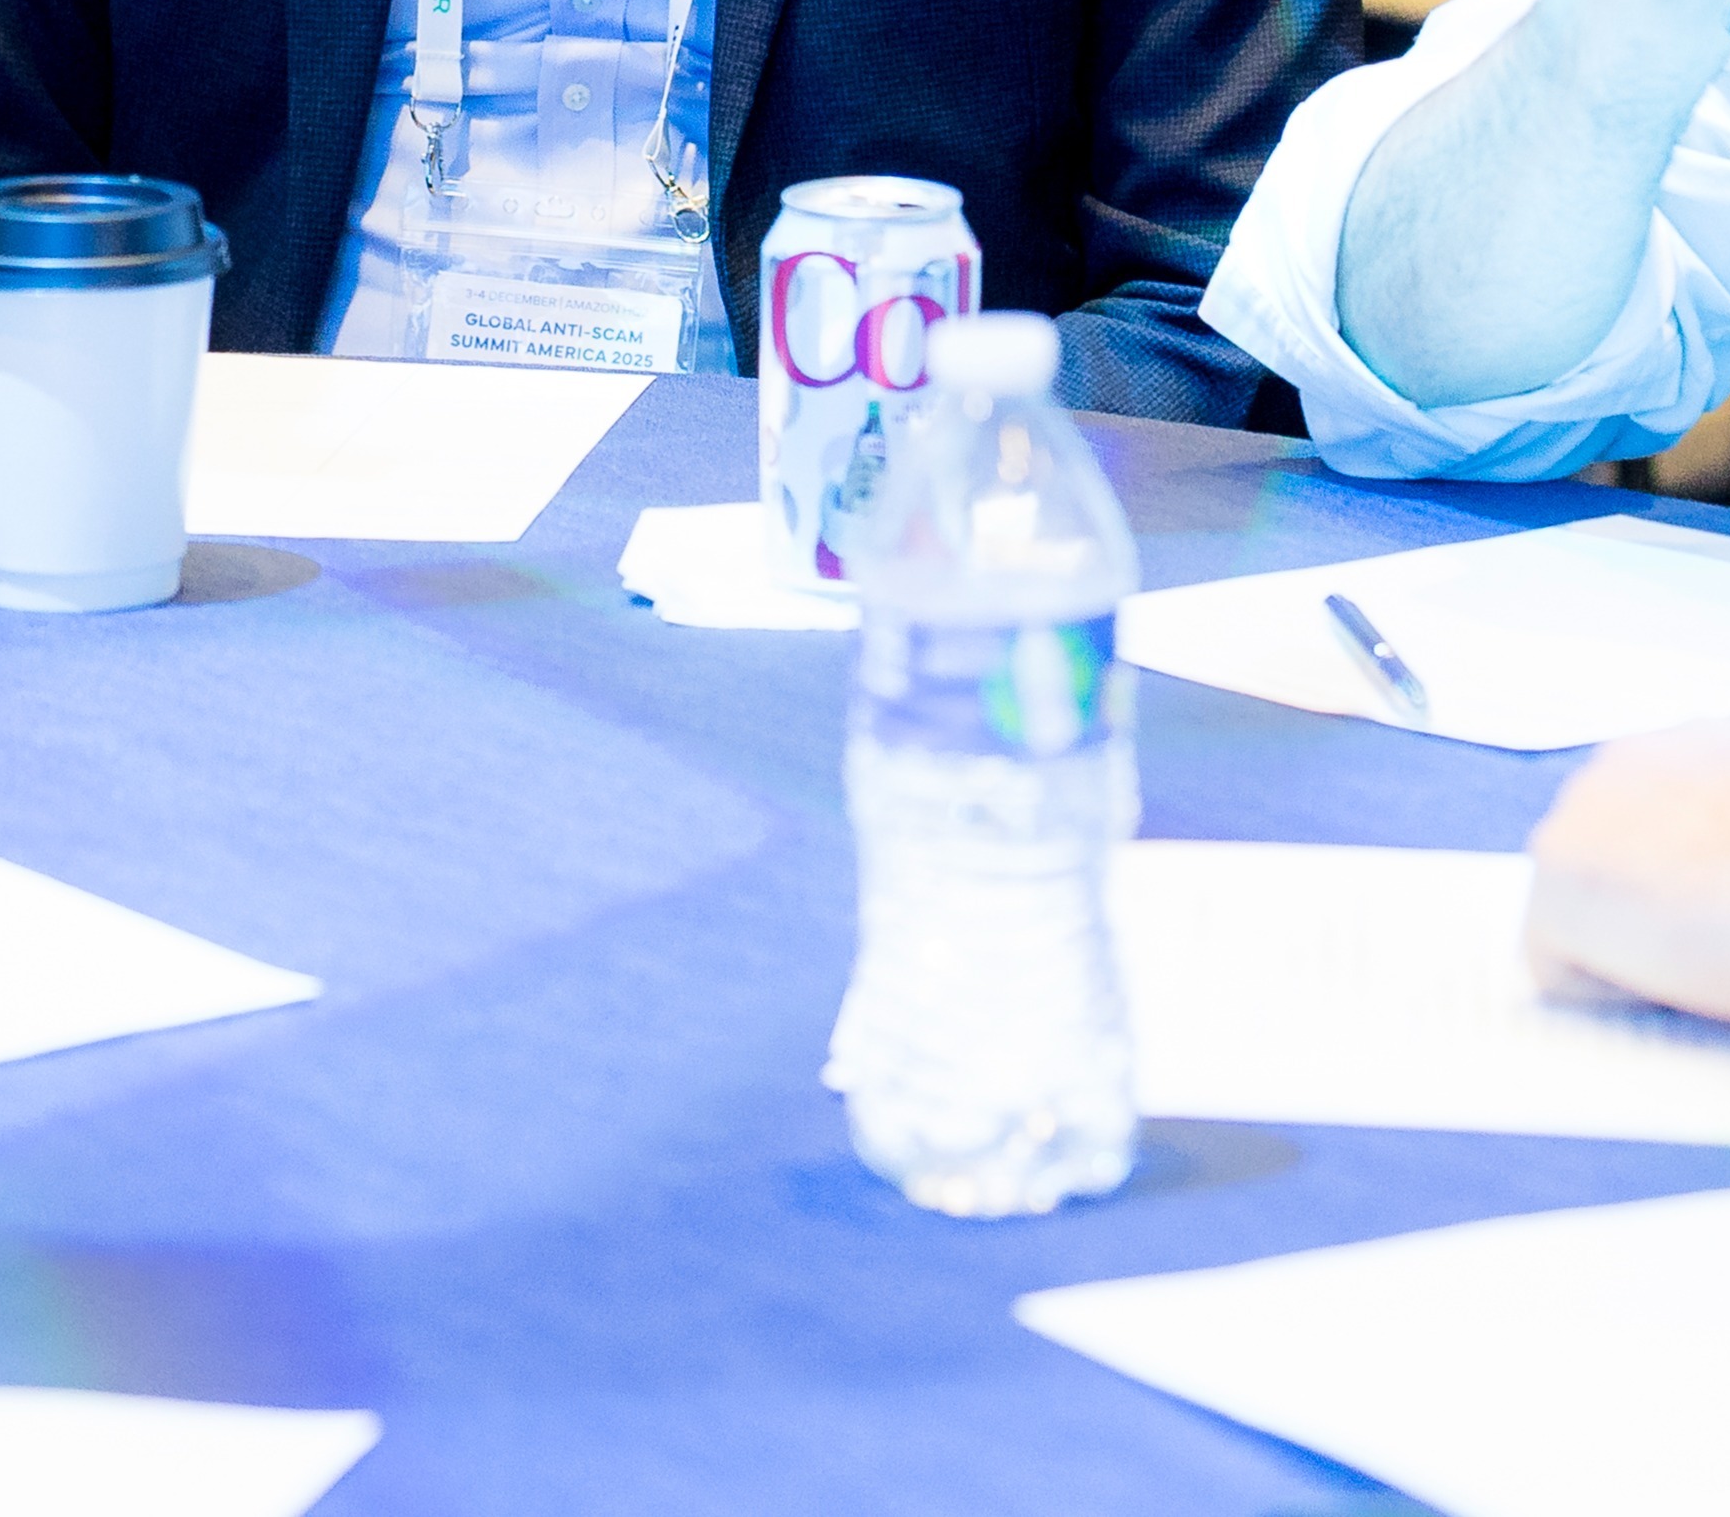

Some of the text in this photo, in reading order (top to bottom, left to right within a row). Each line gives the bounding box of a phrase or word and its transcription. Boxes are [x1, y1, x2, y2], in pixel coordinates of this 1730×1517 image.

[488, 290, 557, 308] DECEMBER
[564, 299, 621, 315] AMAZON
[465, 313, 644, 345] GLOBAL ANTI-SCAM
[450, 334, 654, 368] SUMMIT AMERICA 2025
